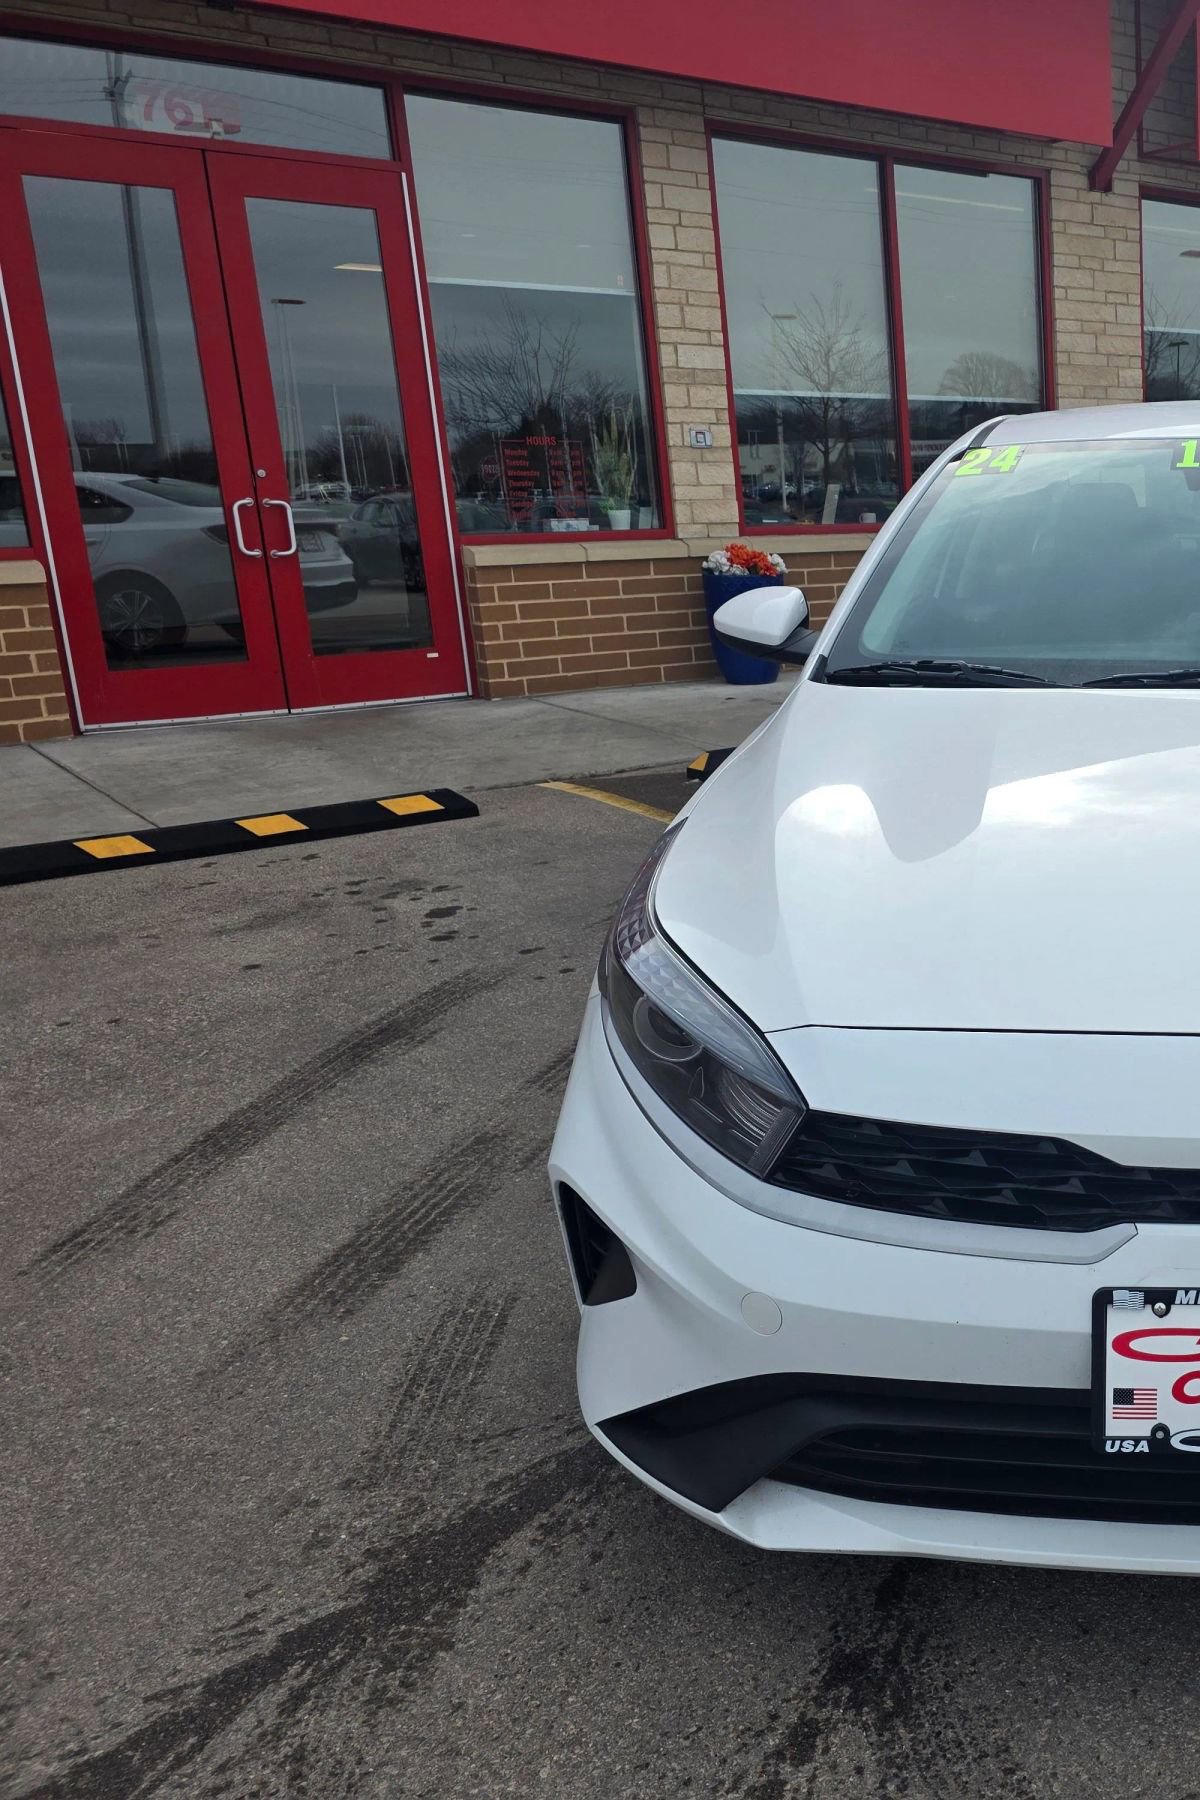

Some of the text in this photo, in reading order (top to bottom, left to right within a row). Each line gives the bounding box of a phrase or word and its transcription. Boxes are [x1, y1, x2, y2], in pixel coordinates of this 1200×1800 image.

[526, 436, 557, 446] HOURS
[954, 445, 1021, 476] 24
[1104, 1439, 1150, 1453] USA
